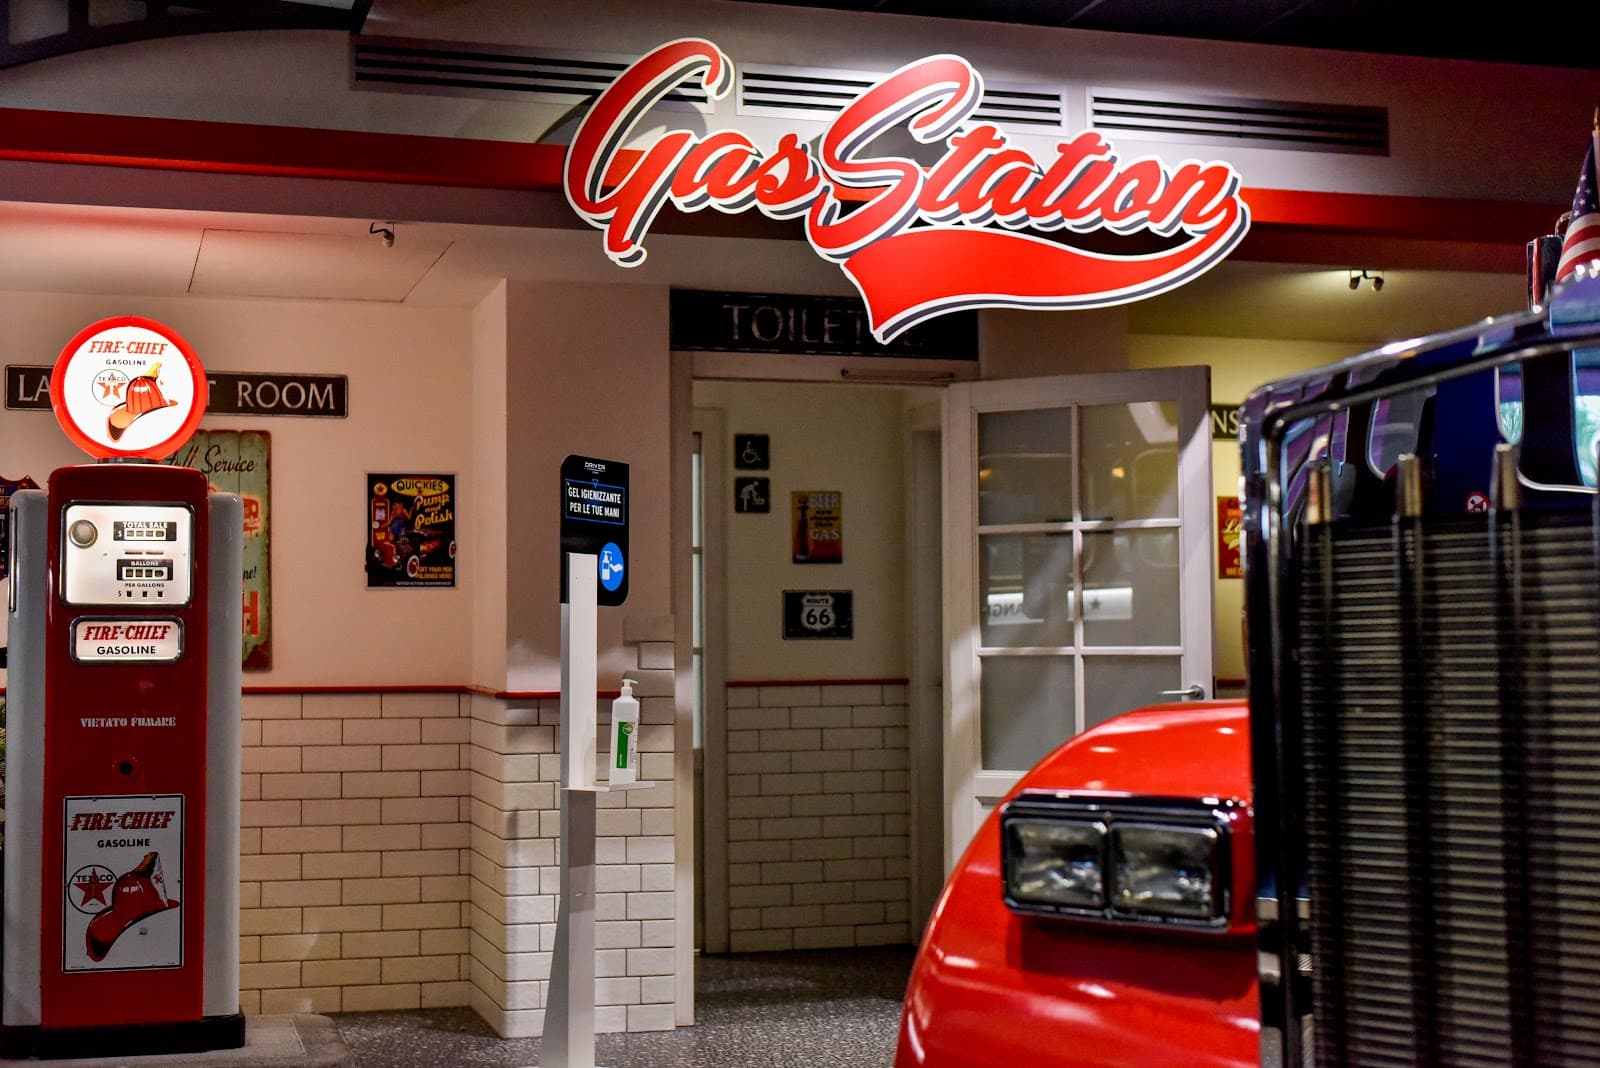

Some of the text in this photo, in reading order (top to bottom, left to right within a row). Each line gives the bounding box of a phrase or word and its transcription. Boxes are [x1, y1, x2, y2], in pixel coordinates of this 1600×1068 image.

[564, 38, 1245, 267] Gas Station
[723, 304, 926, 347] TOILET
[88, 341, 168, 355] FIRE-CHIEF
[237, 381, 335, 410] ROOM
[201, 444, 255, 474] Service
[396, 480, 444, 491] QUICKIES
[414, 494, 450, 510] Pump
[568, 487, 622, 504] GEL IGIENIZZANTE
[569, 502, 620, 518] PER LE TUE MANI
[415, 509, 453, 528] Polish
[811, 530, 839, 541] GAS
[806, 608, 830, 626] 66
[83, 625, 171, 641] FIRE-CHIEF
[97, 645, 156, 655] GASOLINE
[80, 716, 176, 728] VIETATO FUMARE
[71, 811, 175, 831] FIRE-CHIEF
[97, 838, 150, 848] GASOLINE
[76, 874, 113, 882] TEXACO
